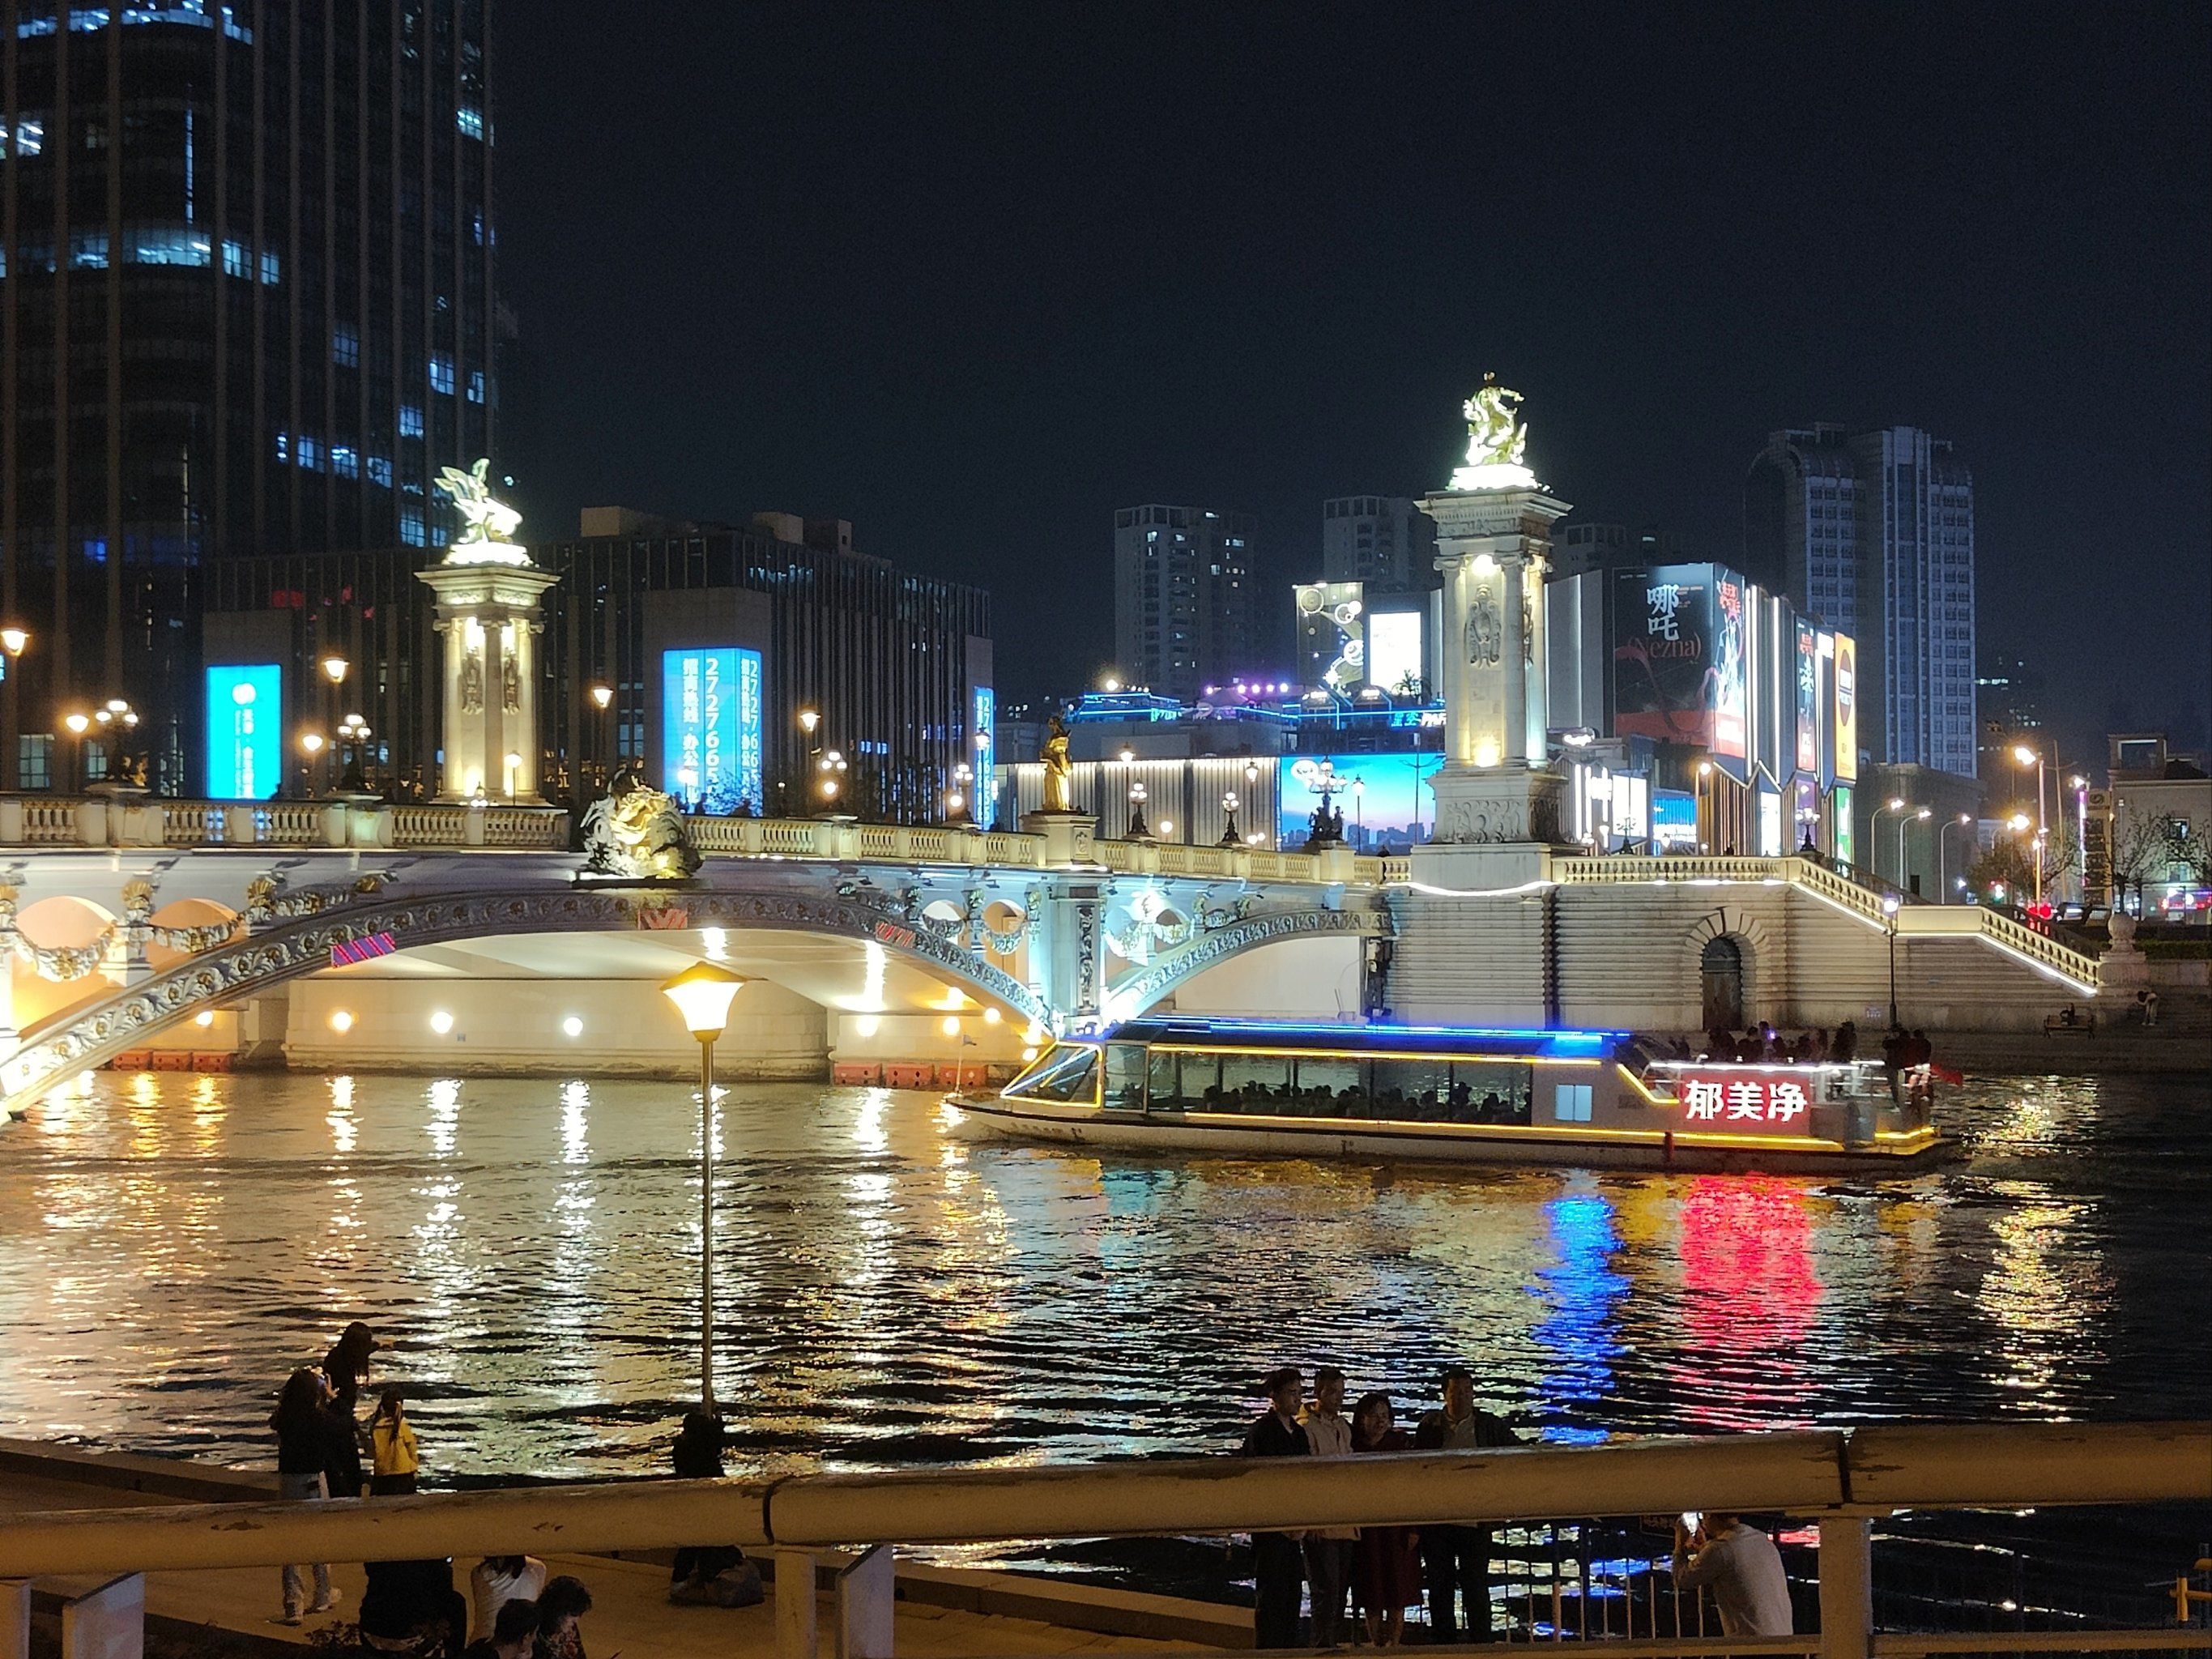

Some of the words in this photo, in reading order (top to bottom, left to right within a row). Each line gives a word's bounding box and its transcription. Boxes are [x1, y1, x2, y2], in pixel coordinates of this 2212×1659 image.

[1647, 584, 1679, 641] 哪吒
[705, 658, 719, 792] 2727665
[1685, 1080, 1808, 1122] 郁美净
